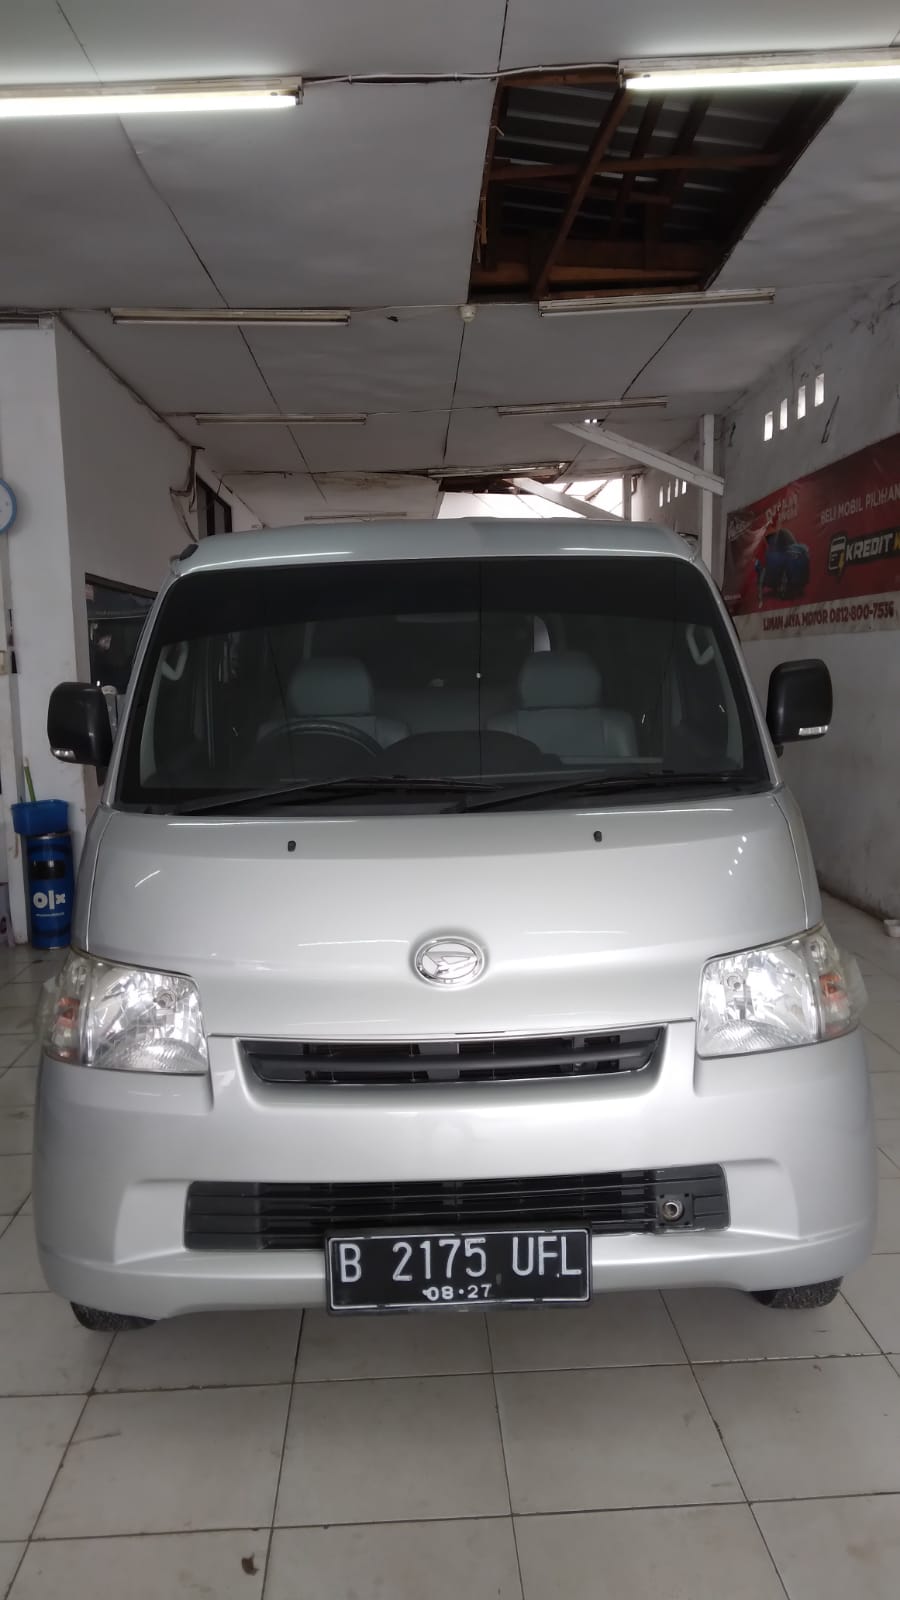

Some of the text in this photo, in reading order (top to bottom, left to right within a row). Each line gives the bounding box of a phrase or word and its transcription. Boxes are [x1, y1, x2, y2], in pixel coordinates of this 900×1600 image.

[820, 505, 837, 525] BELI
[838, 496, 863, 518] MOBIL
[847, 533, 893, 560] KREDIT
[784, 614, 800, 628] JAYA
[801, 610, 828, 626] MOTOR
[33, 890, 65, 910] olx
[339, 1236, 582, 1283] B 2175 UFL
